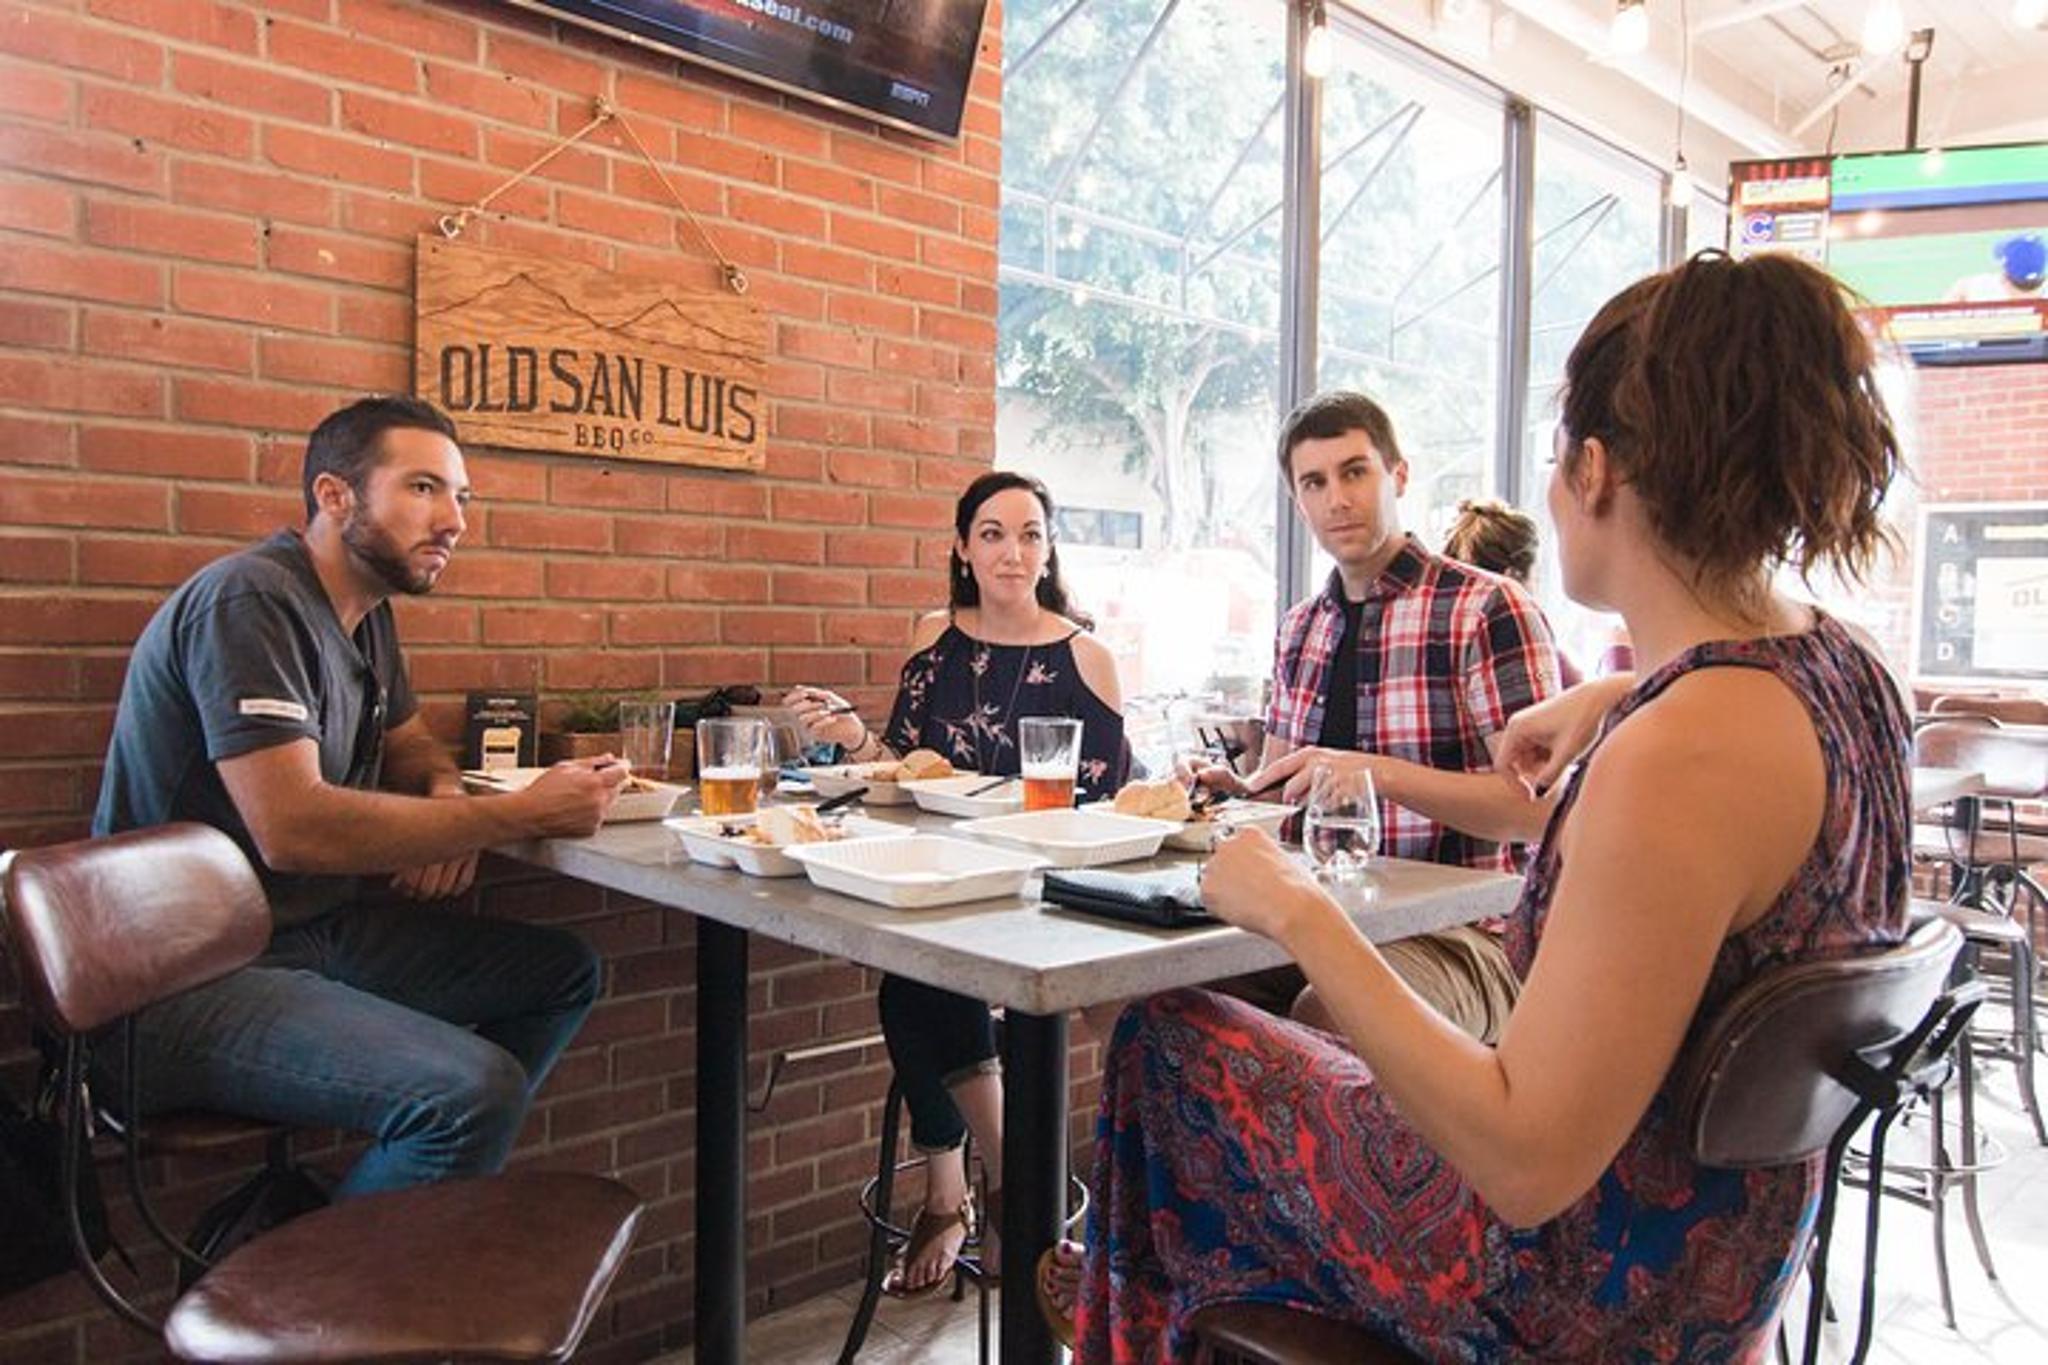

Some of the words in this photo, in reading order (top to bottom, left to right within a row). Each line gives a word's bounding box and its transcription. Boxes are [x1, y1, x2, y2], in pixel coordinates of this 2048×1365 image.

[440, 343, 538, 413] OLD
[549, 348, 643, 422] SAN
[656, 364, 758, 444] LUIS
[575, 423, 623, 451] BBQ
